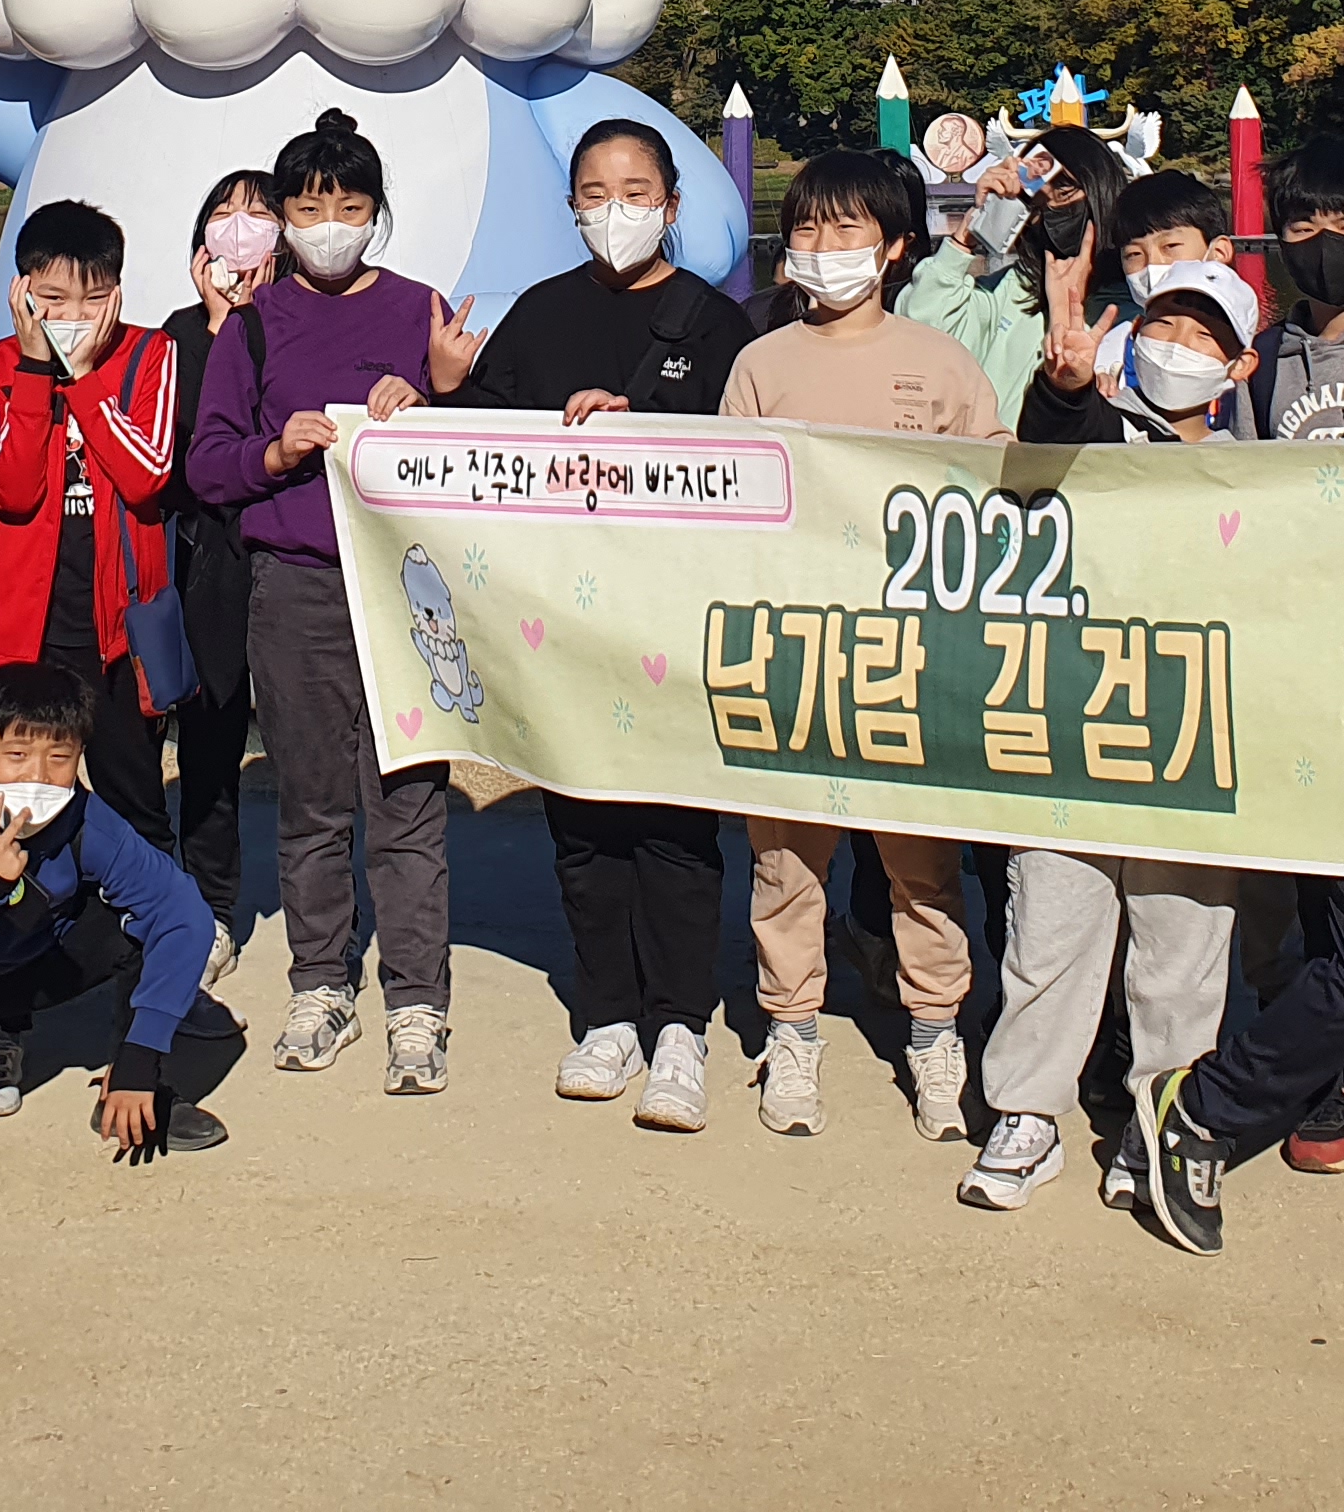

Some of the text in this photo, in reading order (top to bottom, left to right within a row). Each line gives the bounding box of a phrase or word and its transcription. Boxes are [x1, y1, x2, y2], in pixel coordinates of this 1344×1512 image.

[397, 448, 738, 512] 에나 진주와 사랑에 빠지다!
[885, 491, 1086, 617] 2022.
[707, 607, 1233, 789] 남가람 길 걷기
